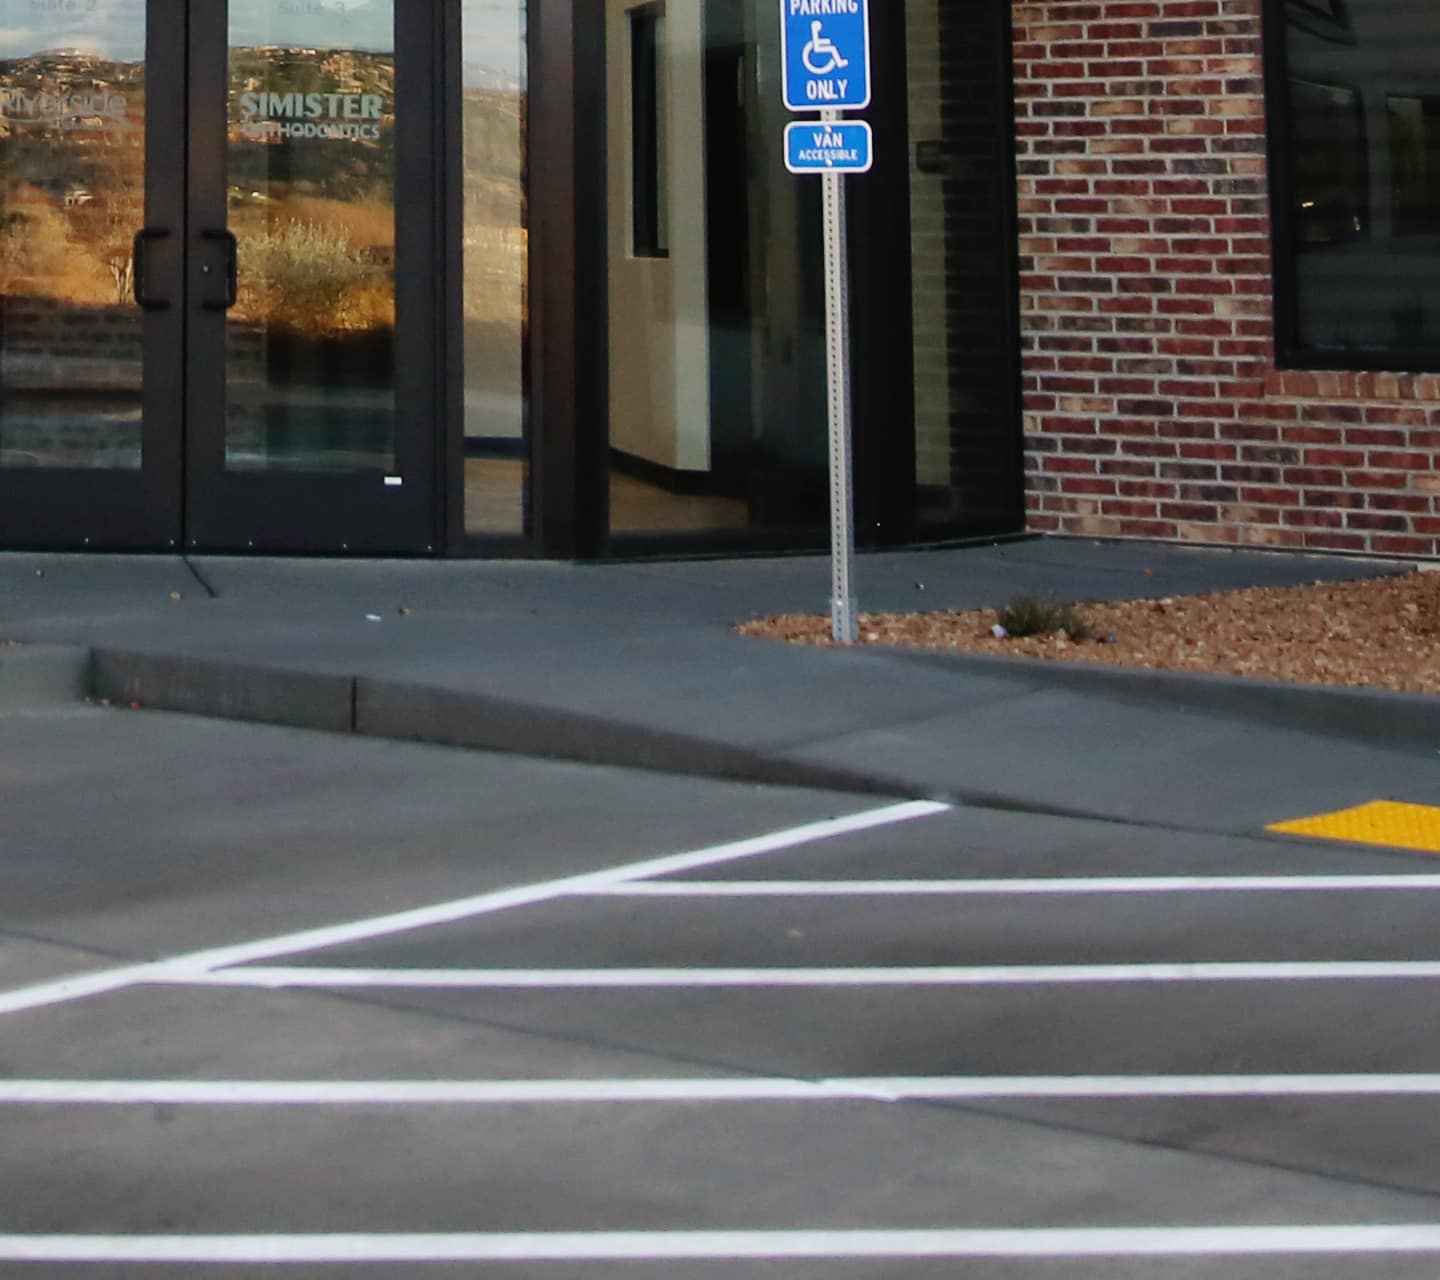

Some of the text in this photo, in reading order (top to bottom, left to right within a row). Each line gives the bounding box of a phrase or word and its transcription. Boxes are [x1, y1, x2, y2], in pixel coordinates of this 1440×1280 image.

[806, 79, 848, 100] ONLY
[239, 92, 384, 120] SIMISTER
[812, 131, 843, 148] VAN
[798, 149, 858, 161] ACCESSIBLE
